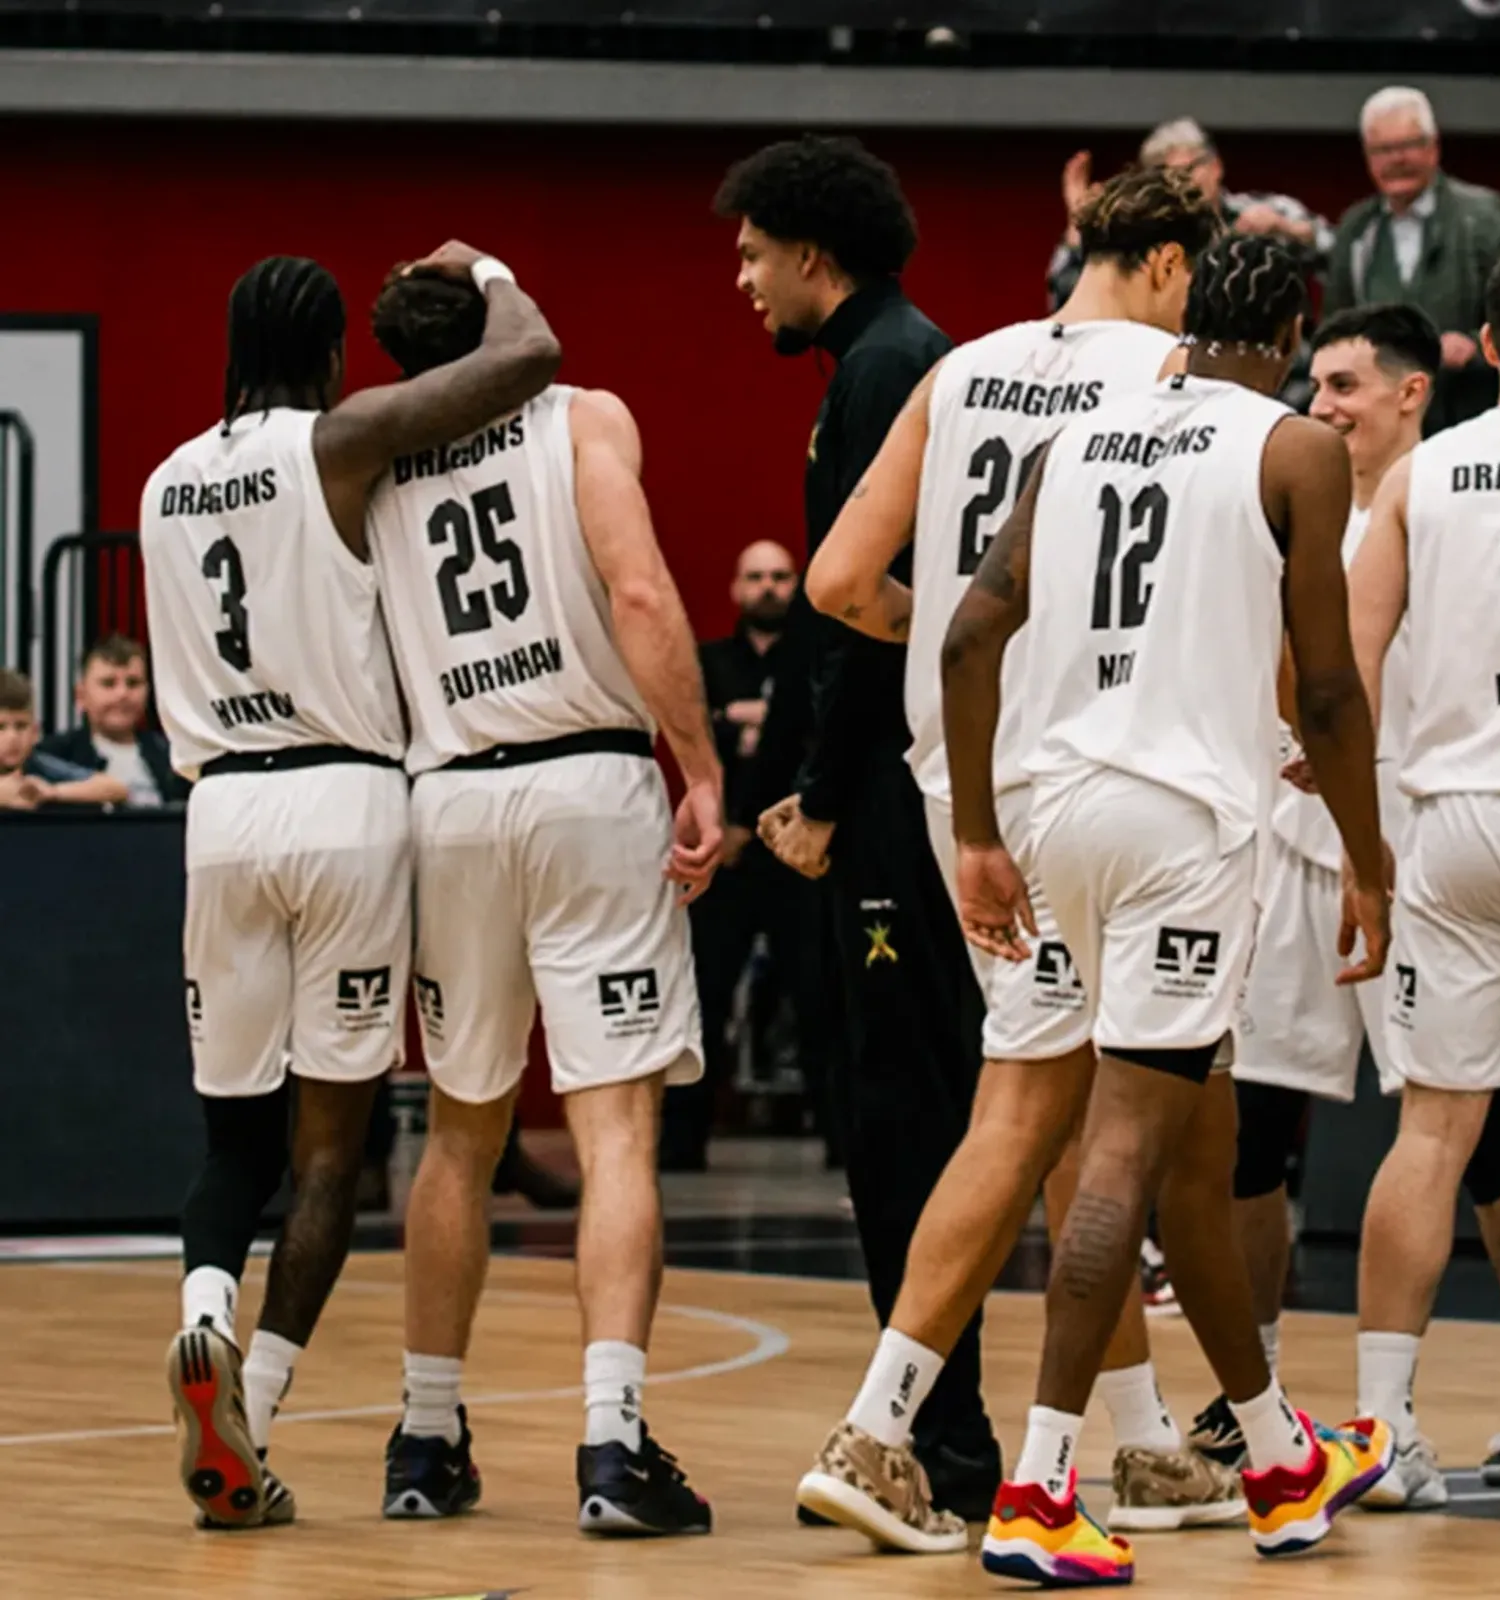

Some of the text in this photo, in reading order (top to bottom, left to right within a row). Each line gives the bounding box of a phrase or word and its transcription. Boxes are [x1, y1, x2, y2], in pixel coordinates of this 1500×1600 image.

[964, 377, 1104, 418] DRAGONS
[161, 468, 277, 518] DRAGONS
[1082, 425, 1217, 468] DRAGONS
[427, 481, 530, 636] 25
[1090, 482, 1170, 630] 12
[202, 535, 254, 673] 3
